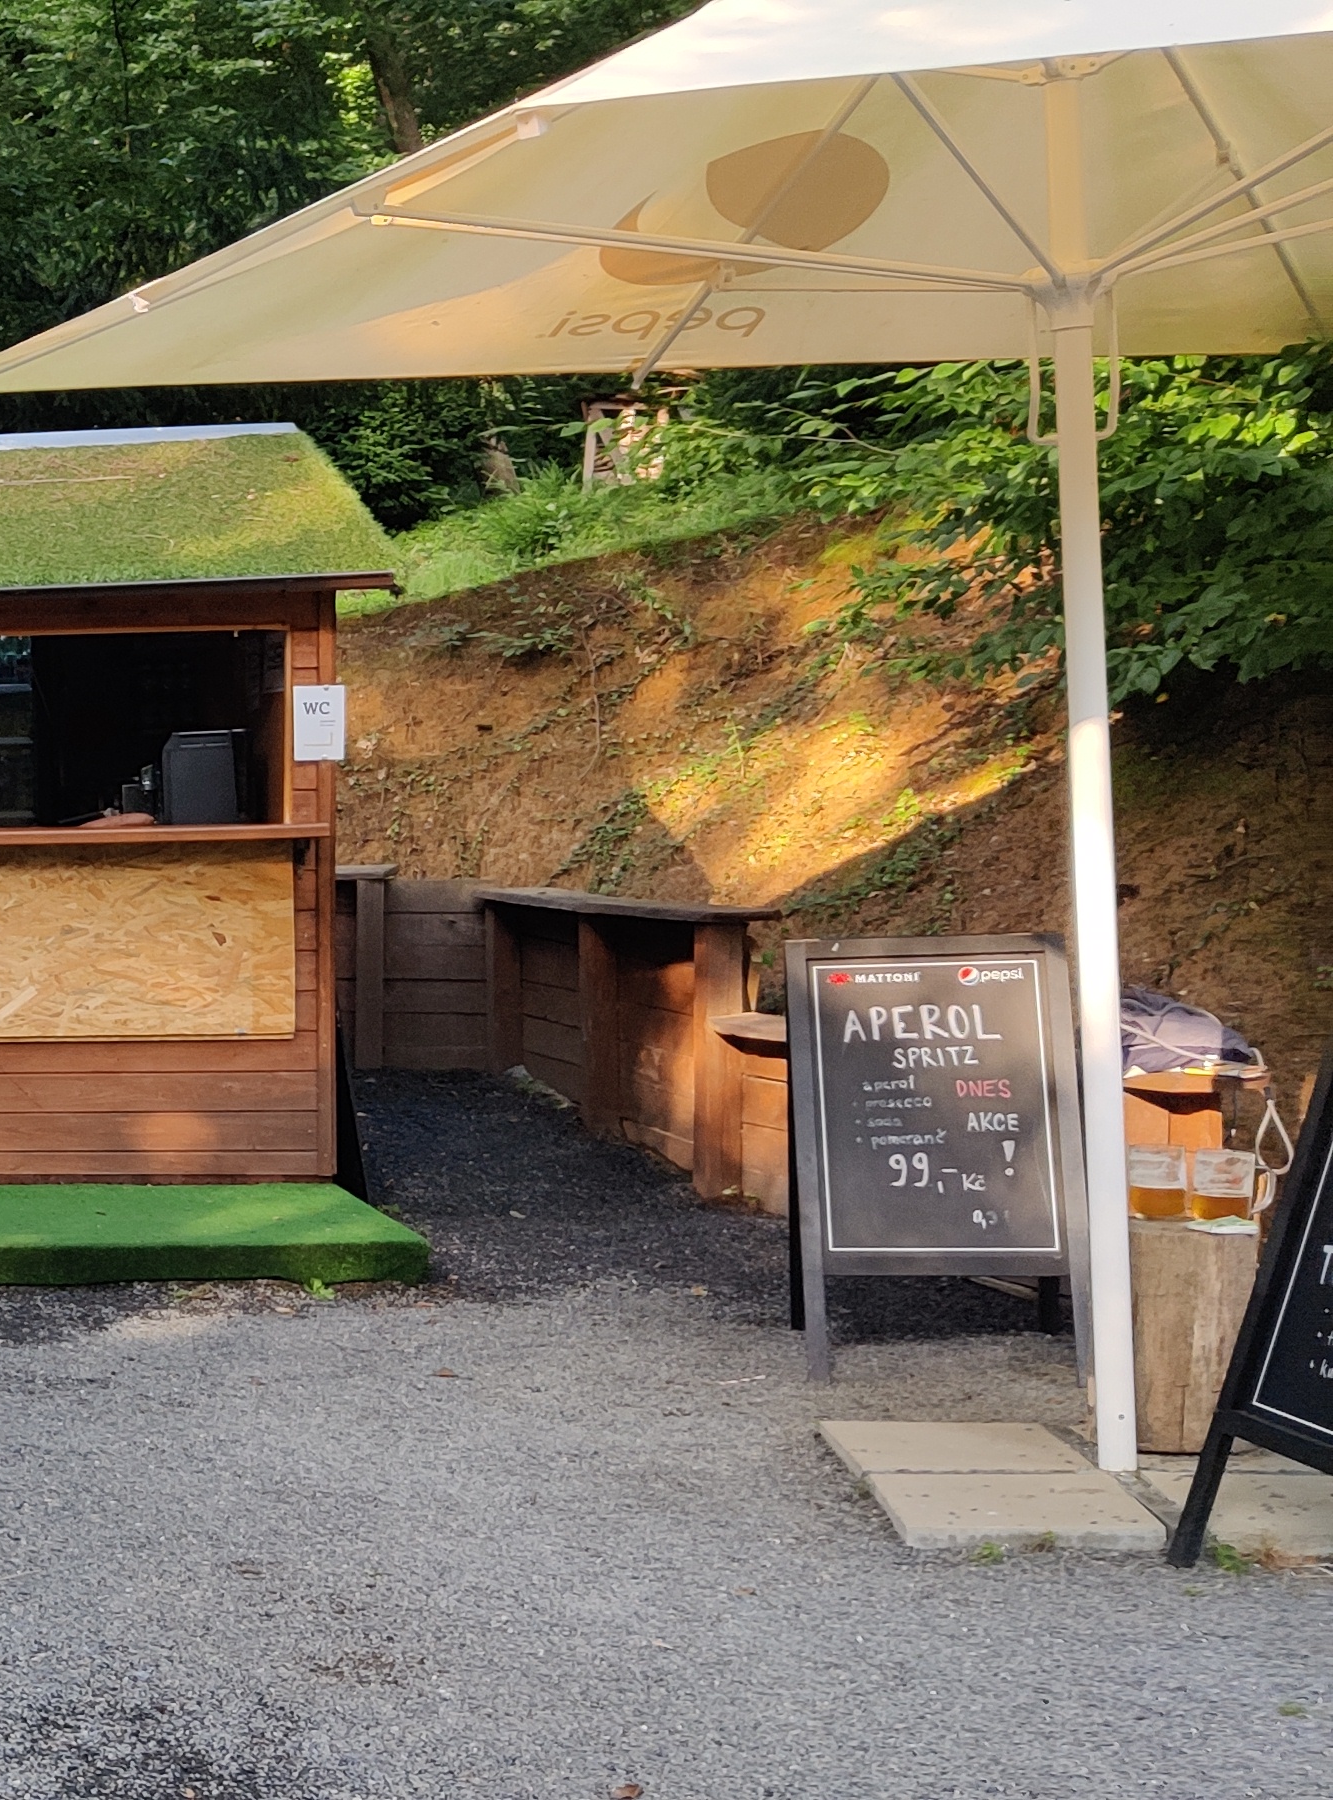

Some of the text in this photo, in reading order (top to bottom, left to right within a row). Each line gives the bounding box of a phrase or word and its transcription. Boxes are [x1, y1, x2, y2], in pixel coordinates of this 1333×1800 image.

[302, 701, 331, 715] WC
[854, 971, 921, 983] MATTONI
[980, 966, 1025, 983] pepsi
[842, 1003, 1003, 1043] APEROL
[892, 1045, 979, 1069] SPRITZ
[862, 1074, 916, 1092] aperol
[955, 1079, 1012, 1099] DNES
[966, 1111, 1020, 1132] AKCE
